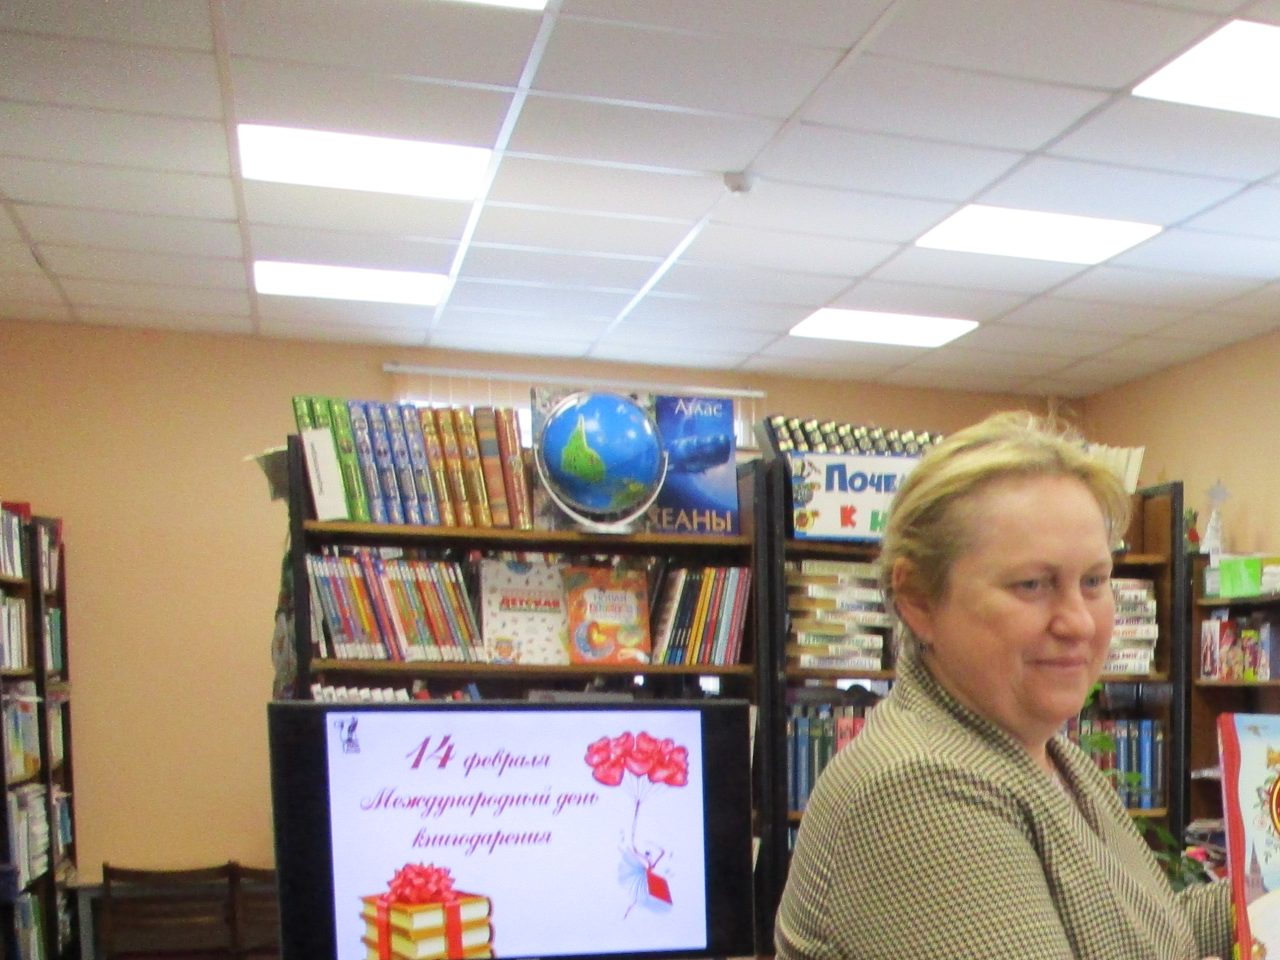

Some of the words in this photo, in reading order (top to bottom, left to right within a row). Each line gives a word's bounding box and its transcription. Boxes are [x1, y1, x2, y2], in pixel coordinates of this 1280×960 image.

[675, 398, 723, 417] Атлас
[405, 734, 455, 769] 14
[463, 747, 550, 777] февраля
[360, 785, 552, 817] Международный
[553, 793, 600, 816] день
[411, 826, 552, 856] книгодарения
